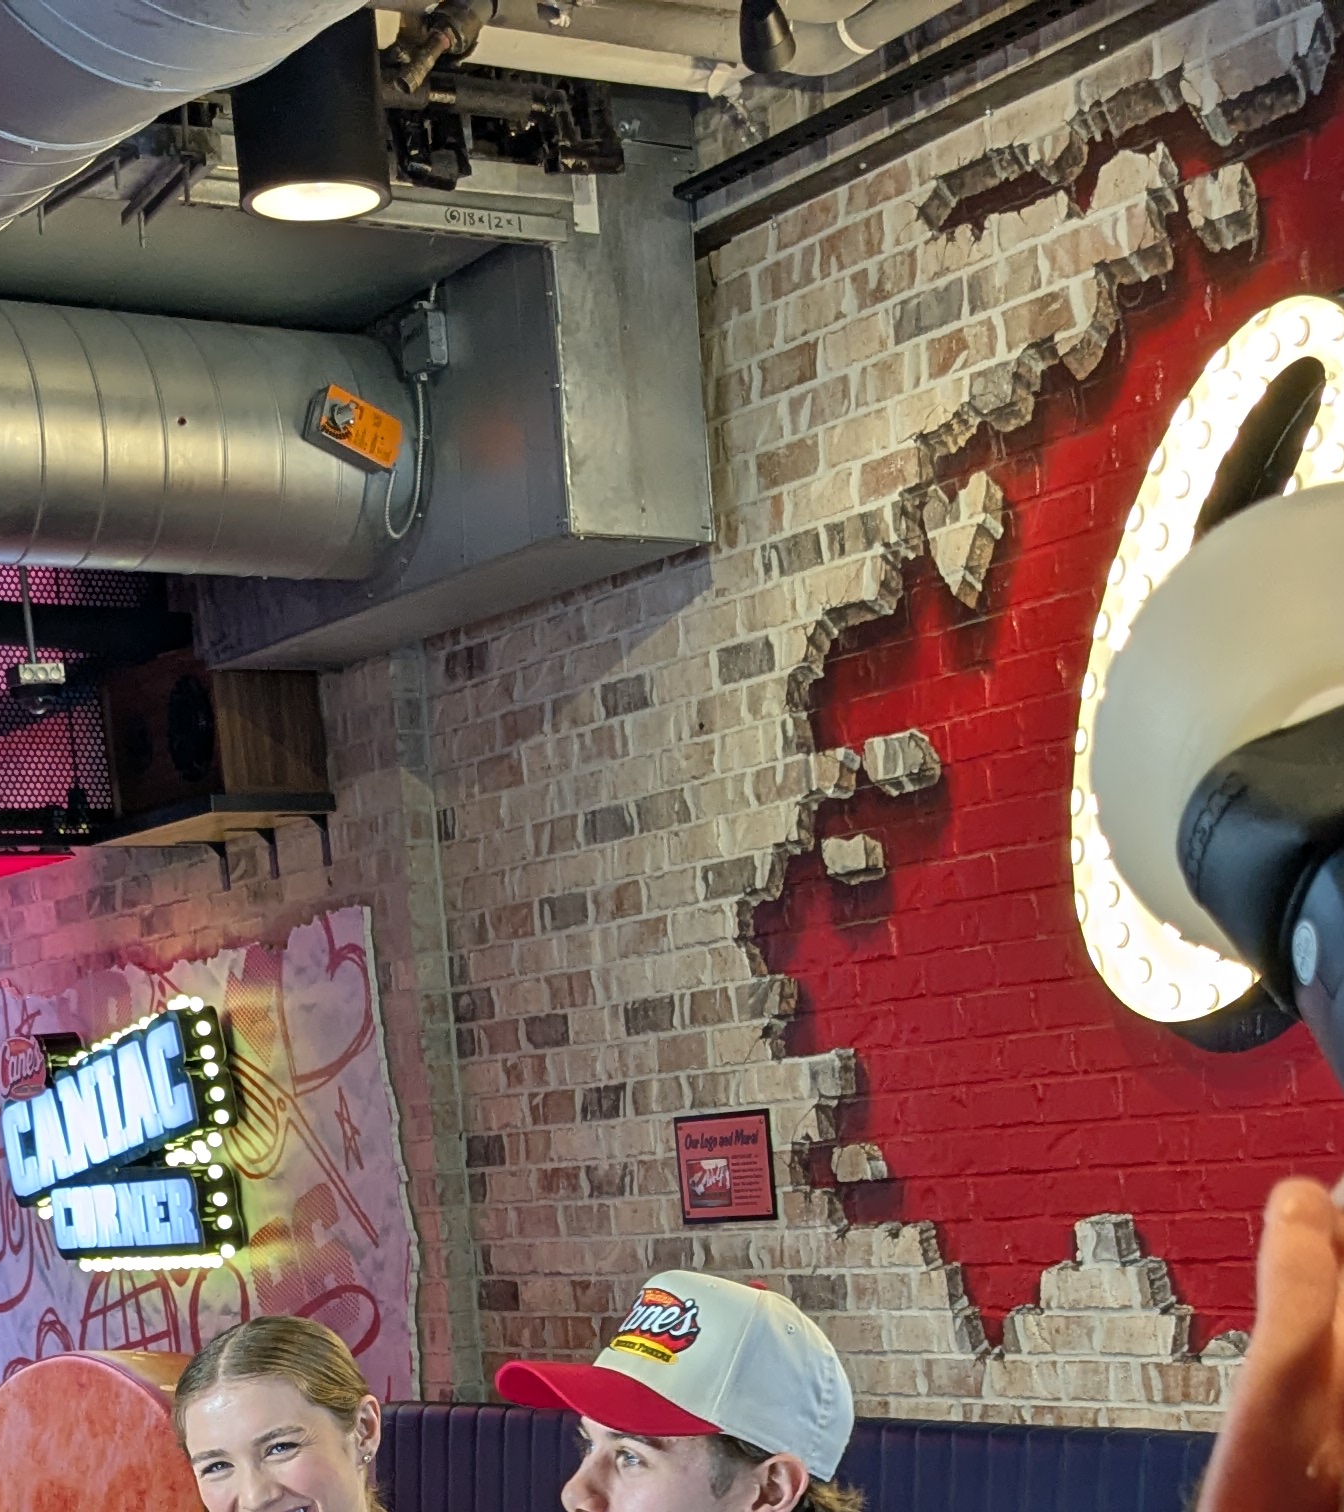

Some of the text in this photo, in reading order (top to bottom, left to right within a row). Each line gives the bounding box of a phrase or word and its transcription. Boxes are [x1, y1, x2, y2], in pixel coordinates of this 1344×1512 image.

[2, 1021, 194, 1197] CANIAC
[684, 1133, 698, 1150] Our
[701, 1132, 717, 1152] Logo
[719, 1131, 733, 1148] and
[51, 1178, 200, 1250] CORNER
